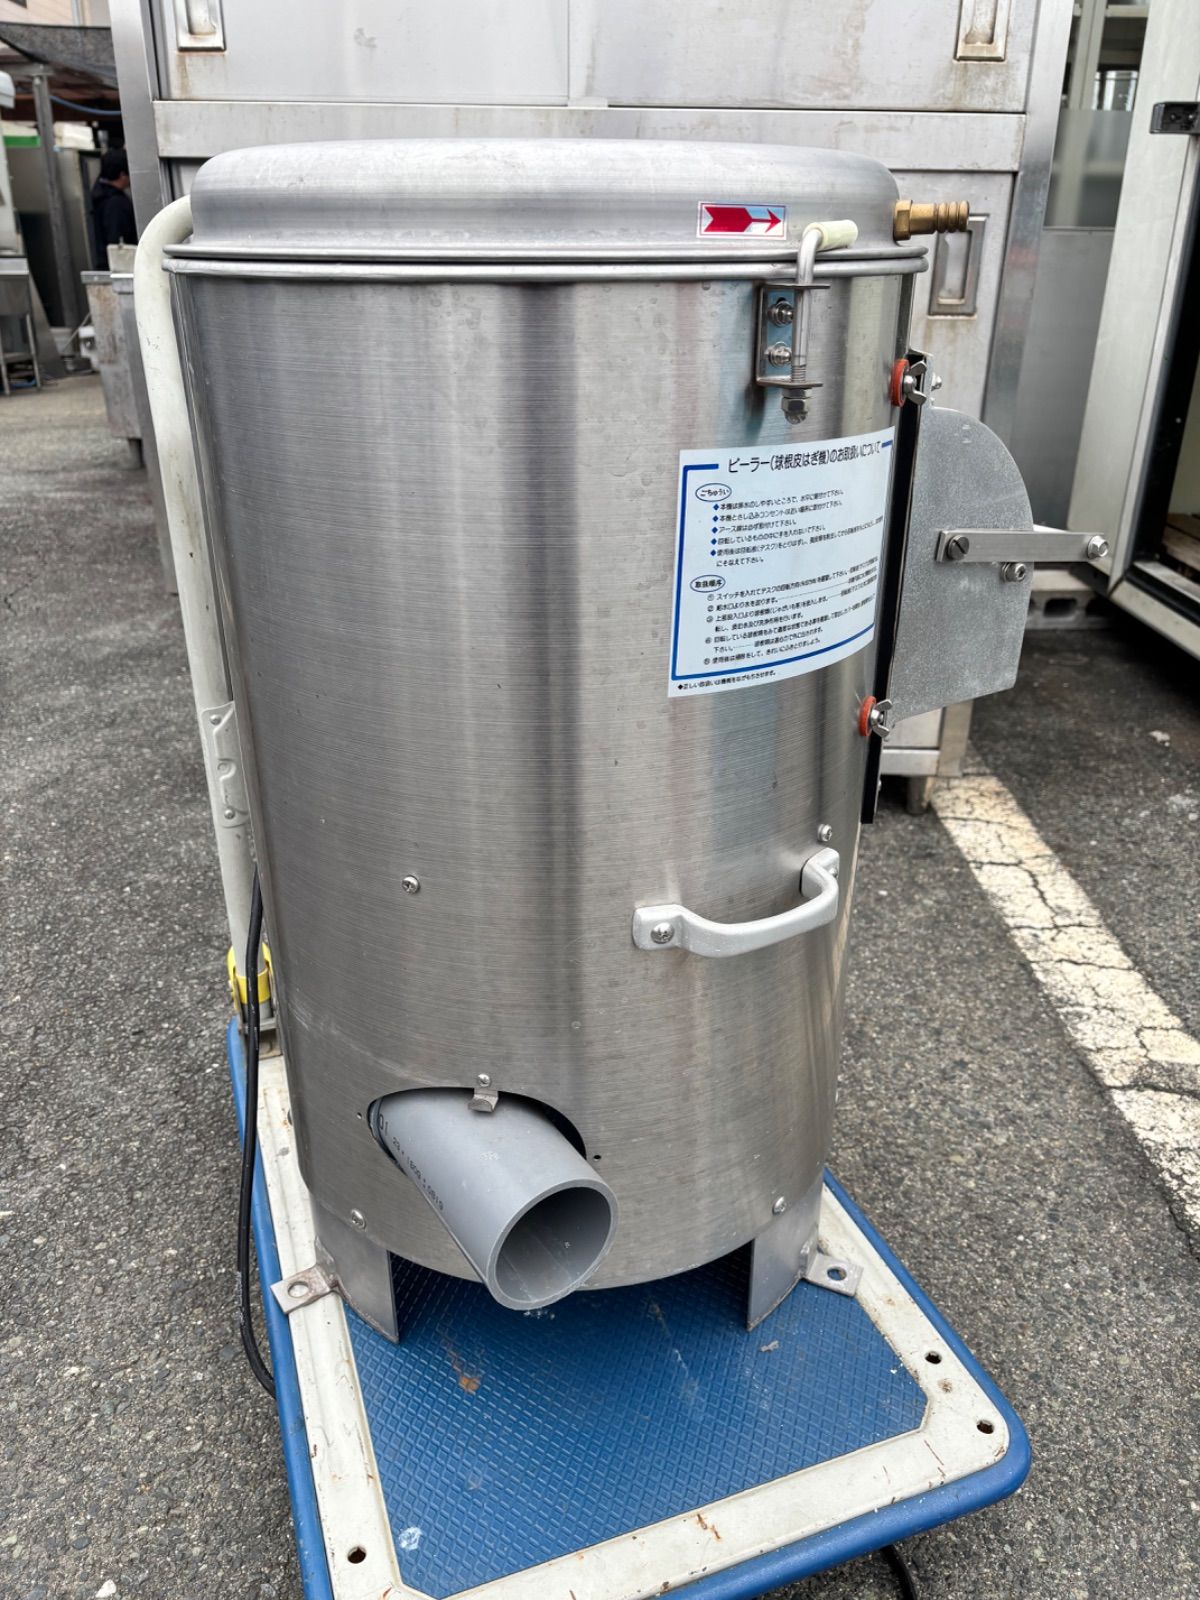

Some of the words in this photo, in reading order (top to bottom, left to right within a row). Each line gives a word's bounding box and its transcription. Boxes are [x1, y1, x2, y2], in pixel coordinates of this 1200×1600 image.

[699, 486, 729, 498] ごちゅうい
